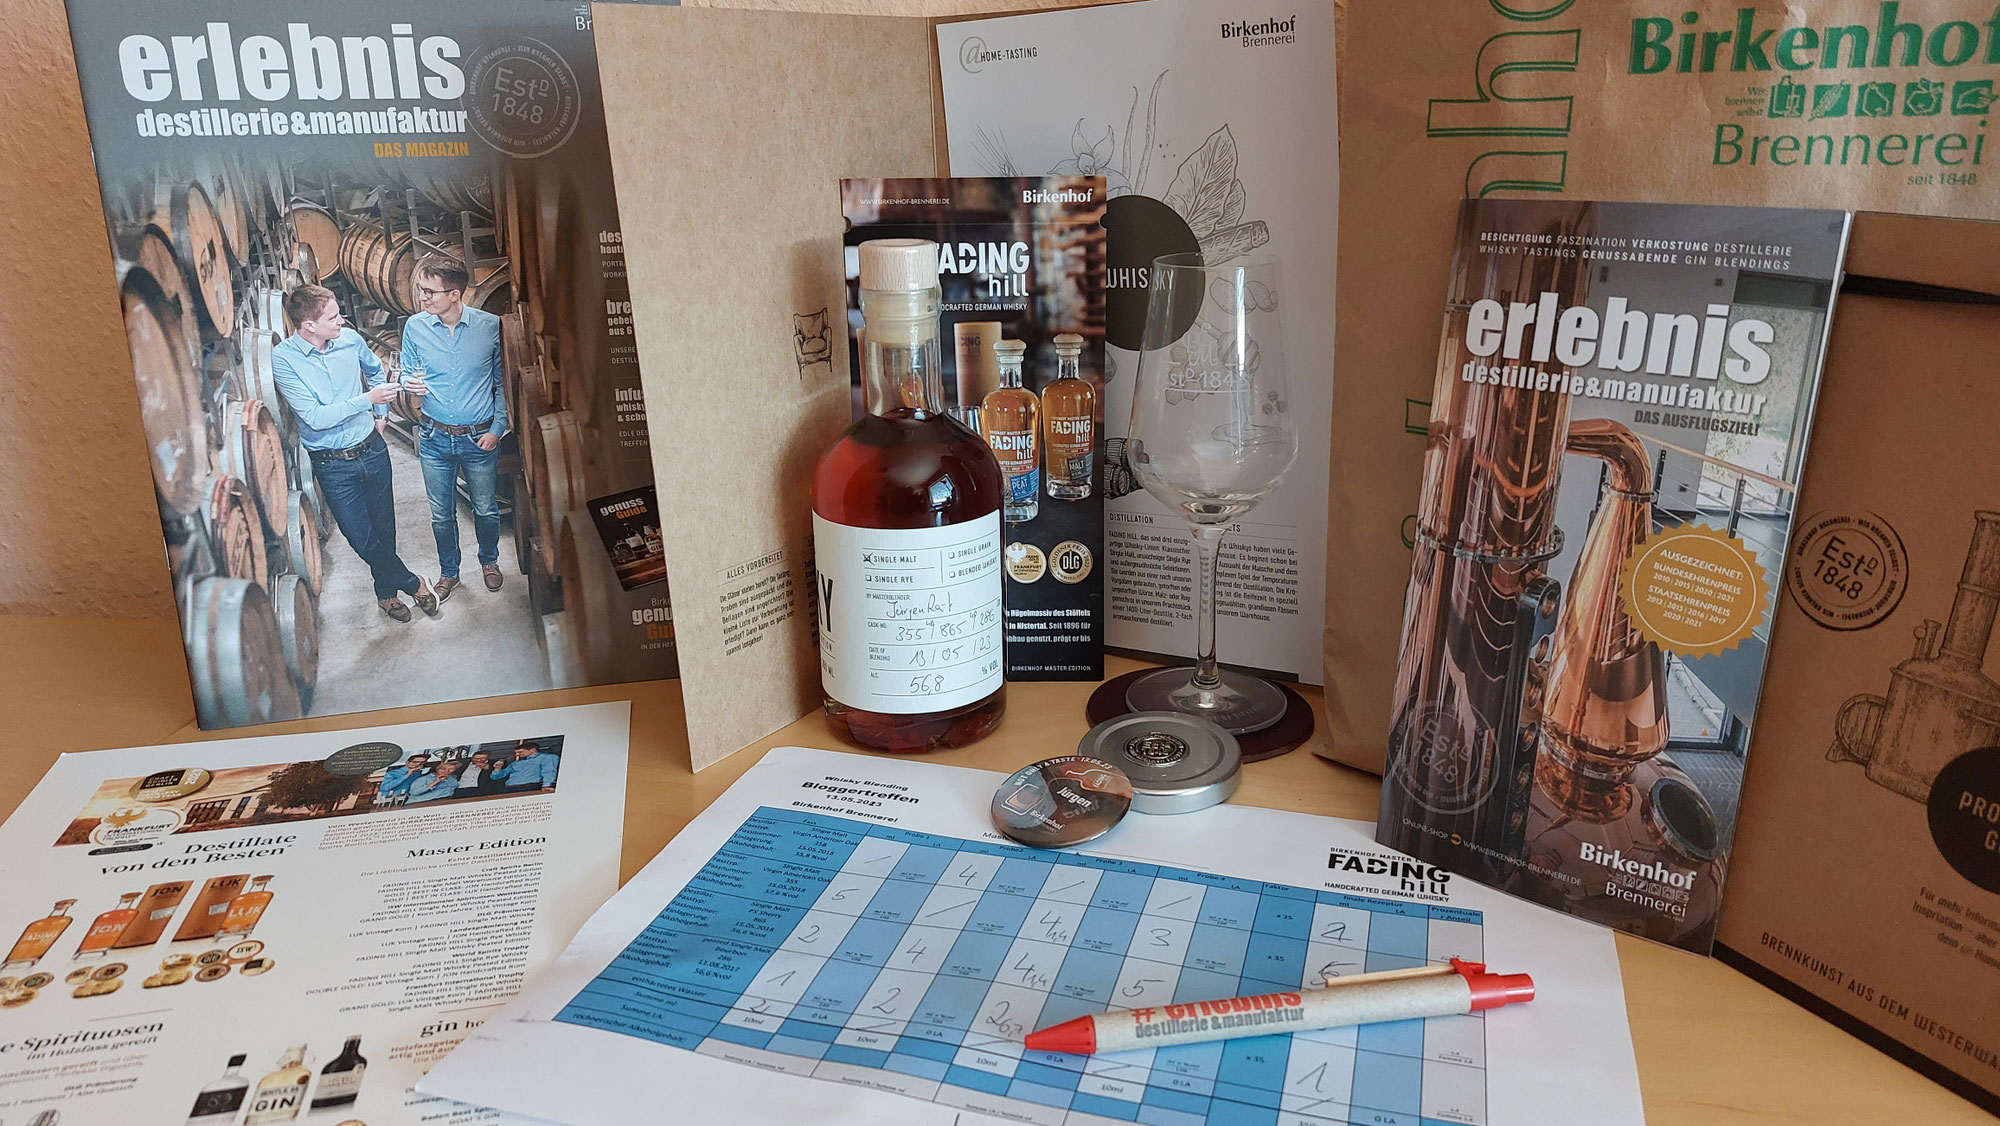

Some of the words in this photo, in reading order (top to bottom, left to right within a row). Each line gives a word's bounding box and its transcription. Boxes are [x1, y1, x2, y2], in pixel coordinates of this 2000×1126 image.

[1220, 15, 1296, 39] Birkenhof
[1242, 32, 1296, 48] Brennerei
[118, 21, 466, 103] erlebnis
[492, 92, 544, 125] 1848
[136, 107, 468, 137] destillerie&manufaktur
[374, 142, 402, 159] DAS
[405, 140, 469, 158] MAGAZIN
[1712, 119, 1988, 168] Brennerei
[1907, 171, 1936, 187] seit
[1938, 171, 1977, 187] 1848
[1022, 188, 1092, 204] Birkenhof
[1480, 231, 1553, 244] BESICHTIGUNG
[1556, 235, 1627, 247] FASZINATION
[1631, 238, 1710, 252] VERKOSTUNG
[1713, 243, 1793, 257] DESTILLERIE
[1479, 245, 1518, 255] WHISKY
[1522, 247, 1577, 258] TASTINGS
[1582, 250, 1678, 264] GENUSSABENDE
[1684, 255, 1707, 266] GIN
[1714, 256, 1792, 271] BLENDINGS
[988, 273, 1029, 297] hill
[606, 299, 631, 315] bre
[974, 303, 1002, 311] GERMAN
[1003, 303, 1028, 311] WHISKY
[1465, 291, 1775, 385] erlebnis
[1461, 360, 1767, 416] destillerie&manufaktur
[1050, 419, 1091, 434] FADING
[1634, 410, 1662, 427] DAS
[1661, 412, 1760, 437] AUSFLUGSZIEL!
[989, 434, 1033, 450] FADING
[1075, 432, 1090, 443] hill
[1016, 448, 1033, 460] hill
[1012, 478, 1028, 490] PEAT
[600, 497, 644, 517] genuss
[615, 505, 647, 520] Guide
[1109, 512, 1154, 524] DISTILLATION
[899, 555, 917, 563] MALT
[957, 546, 977, 558] SINGLE
[1062, 550, 1080, 570] DLG
[726, 567, 745, 580] ALLES
[746, 550, 783, 572] VORBEREITET
[958, 565, 982, 577] BLENDED
[1659, 548, 1744, 582] AUSGEZEICHNET:
[874, 575, 898, 584] SINGLE
[900, 575, 914, 583] RYE
[1652, 572, 1670, 583] 2010
[1673, 577, 1691, 589] 2015
[1694, 584, 1713, 596] 2020
[1716, 590, 1735, 603] 2021
[1653, 561, 1743, 596] BUNDESEHRENPREIS
[1813, 559, 1863, 600] 1848
[1646, 594, 1665, 606] 2012
[1667, 600, 1685, 612] 2015
[1687, 606, 1705, 618] 2016
[1709, 612, 1727, 625] 2017
[1647, 583, 1731, 618] STAATSEHRENPREIS
[1052, 609, 1065, 617] des
[1662, 609, 1681, 622] 2020
[1684, 615, 1703, 628] 2021
[1016, 622, 1048, 630] Nistertal.
[1080, 621, 1091, 630] für
[1080, 634, 1091, 642] bis
[1050, 757, 1076, 765] TASTE
[1414, 739, 1459, 784] 1848
[801, 781, 920, 805] Bloggertreffen
[824, 775, 862, 786] Whisky
[863, 780, 909, 791] Blending
[825, 793, 883, 807] 13.05.2023
[1056, 786, 1093, 808] Jürgen
[791, 801, 844, 813] Birkenhof
[845, 808, 899, 823] Brennerei
[1029, 809, 1066, 831] Birkenhof
[106, 823, 173, 835] FRANKFURT
[1402, 817, 1449, 840] ONLINE-SHOP
[184, 834, 297, 854] Destillate
[406, 843, 470, 859] Master
[478, 835, 547, 852] Edition
[813, 834, 845, 844] American
[1330, 847, 1377, 858] BIRKENHOF
[1379, 852, 1414, 863] MASTER
[100, 863, 145, 877] von
[151, 856, 197, 870] den
[958, 864, 977, 886] 4
[1327, 853, 1450, 883] FADING
[1578, 841, 1697, 891] Birkenhof
[1324, 881, 1380, 894] HANDCRAFTED
[1381, 887, 1415, 898] GERMAN
[1416, 893, 1450, 903] WHISKY
[1400, 877, 1449, 896] hill
[1368, 897, 1403, 908] Rezeptur
[1605, 881, 1688, 918] Brennerei
[797, 924, 820, 944] 2
[1149, 927, 1173, 947] 3
[906, 938, 925, 964] 4
[1122, 979, 1166, 997] 5
[872, 987, 902, 1015] 2
[1760, 931, 1845, 985] BRENNKUNST
[1846, 979, 1876, 1002] AUS
[1878, 995, 1909, 1021] DEM
[1913, 1012, 2000, 1071] WESTERWA
[20, 1021, 165, 1051] Spirituosen
[420, 1020, 459, 1038] gin
[26, 1051, 47, 1061] im
[111, 1034, 159, 1051] gereift
[254, 1095, 297, 1112] GIN
